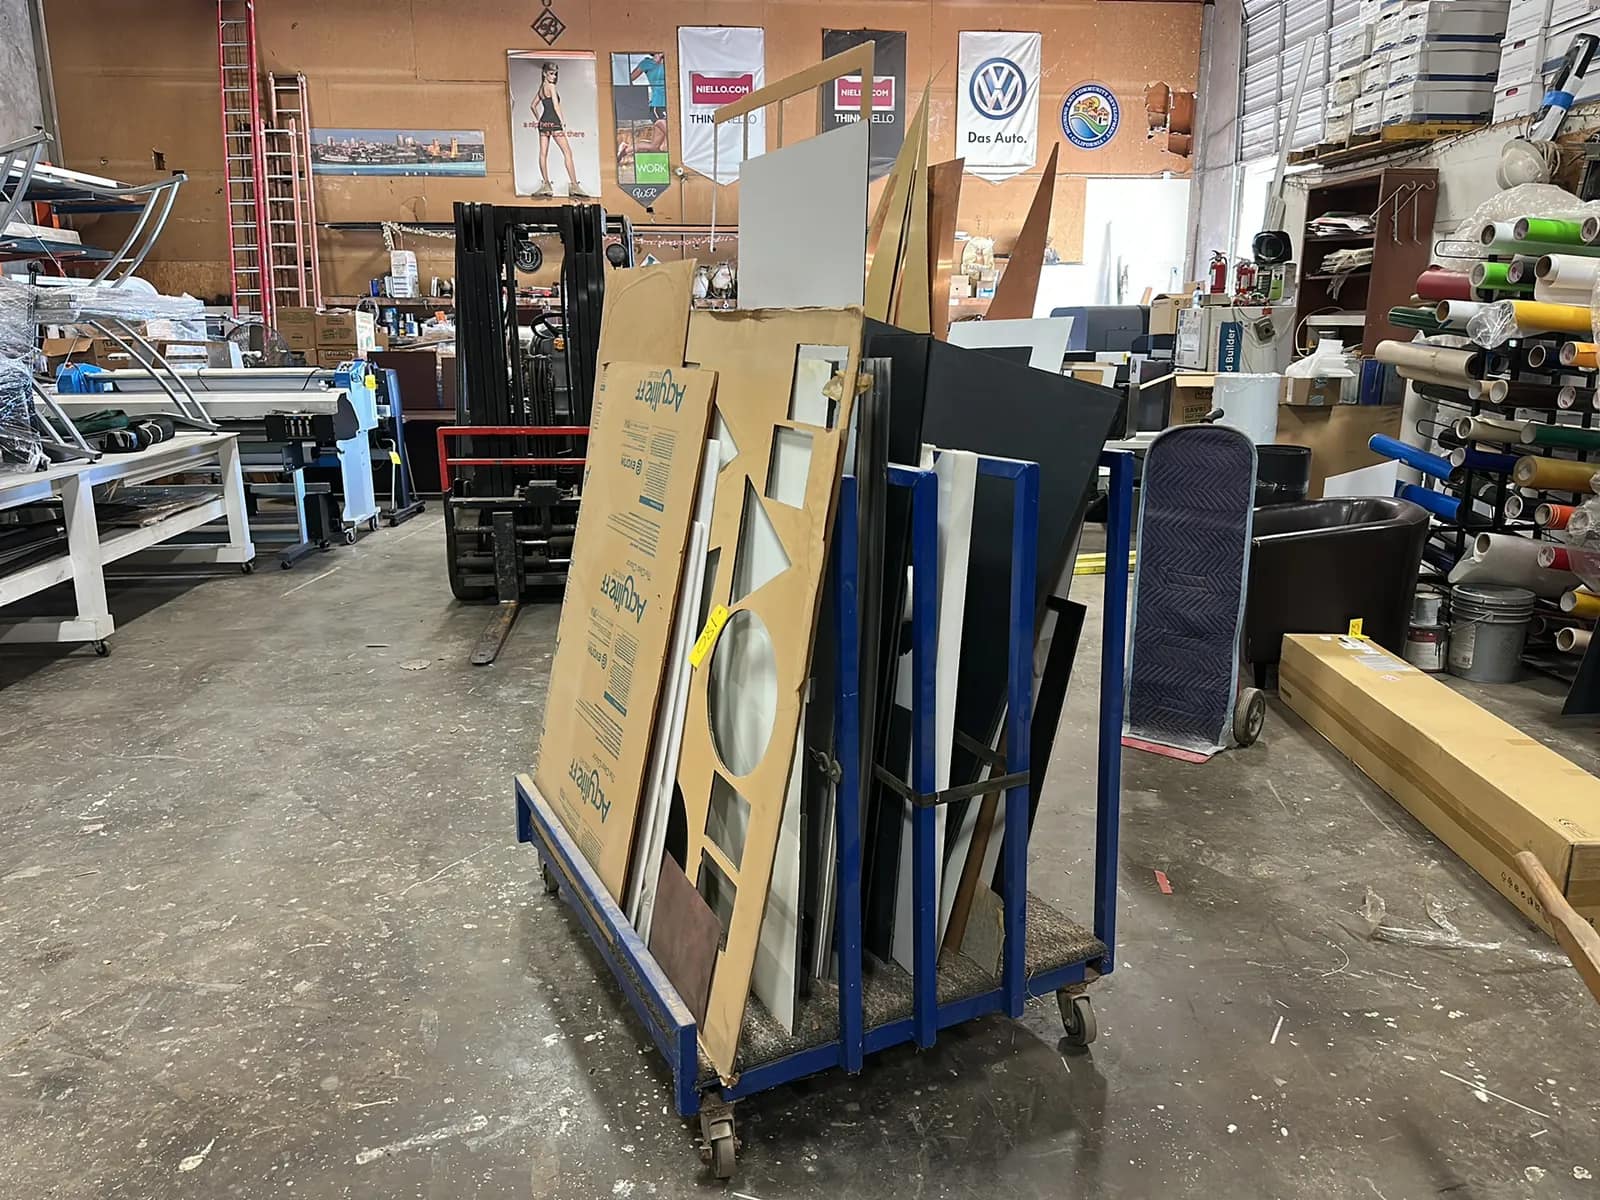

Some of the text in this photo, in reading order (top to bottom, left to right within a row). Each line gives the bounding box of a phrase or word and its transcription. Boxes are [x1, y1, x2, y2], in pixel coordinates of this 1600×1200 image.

[695, 85, 749, 94] NIELLO.COM
[566, 130, 585, 138] there
[968, 131, 1027, 144] Das Auto.
[636, 163, 667, 173] WORK
[1225, 328, 1236, 363] Builder
